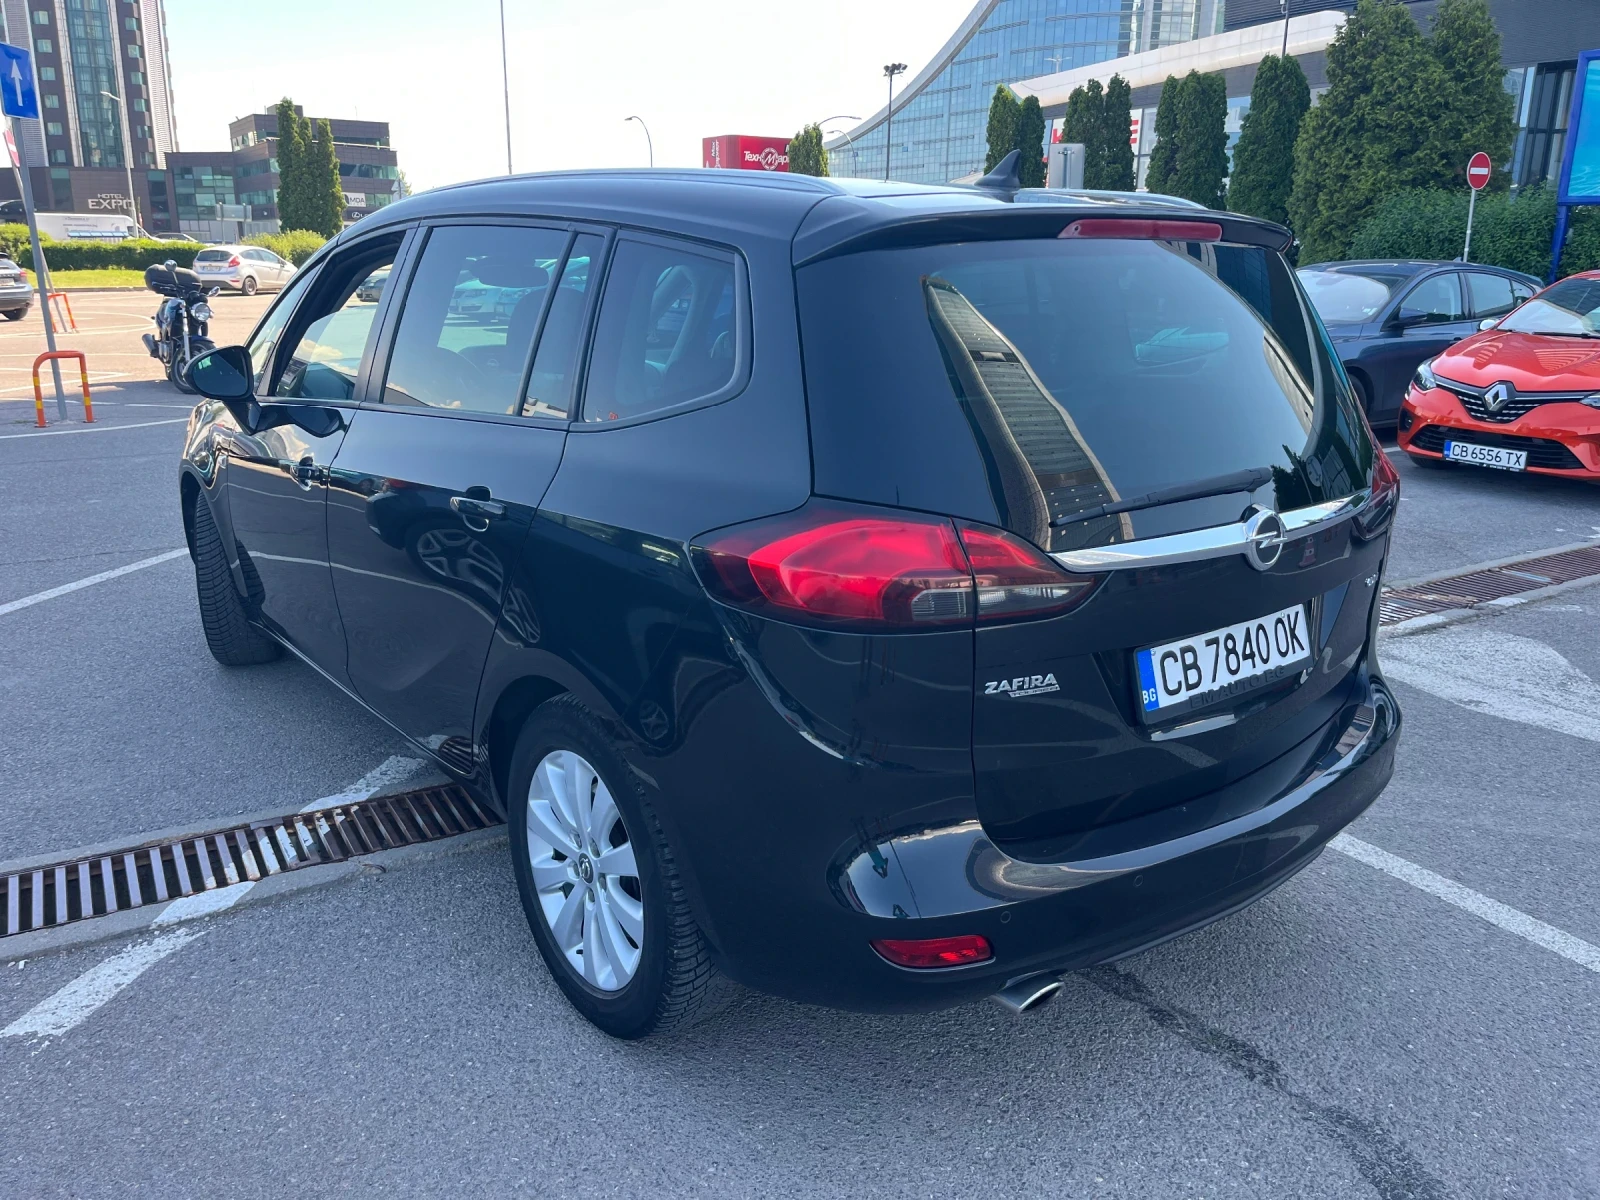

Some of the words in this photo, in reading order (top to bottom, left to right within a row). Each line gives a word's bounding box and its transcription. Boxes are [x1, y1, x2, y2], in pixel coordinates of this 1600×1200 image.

[1452, 444, 1468, 457] CB
[1471, 447, 1502, 463] 6556
[1506, 452, 1522, 466] TX
[1159, 644, 1203, 696] CB
[1204, 623, 1271, 683] 7840
[1274, 611, 1305, 658] OK
[984, 673, 1058, 694] ZAFIRA
[1142, 688, 1157, 704] BG
